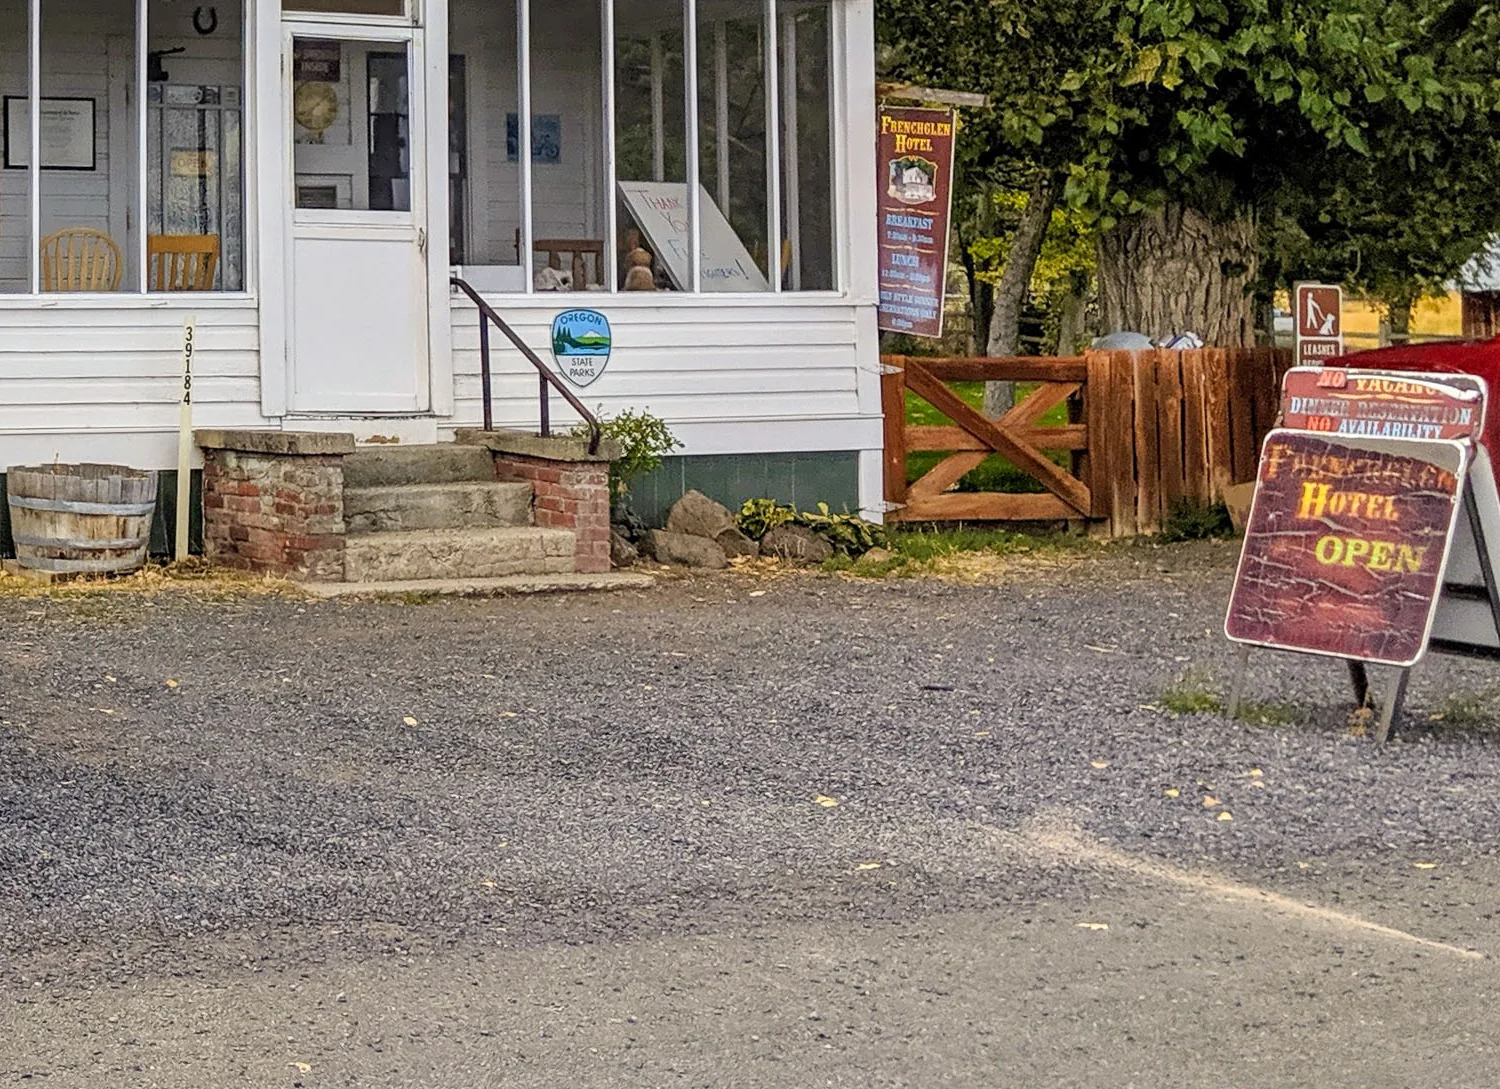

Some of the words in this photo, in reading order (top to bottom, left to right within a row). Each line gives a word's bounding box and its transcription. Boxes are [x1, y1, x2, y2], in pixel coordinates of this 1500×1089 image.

[881, 115, 951, 137] FRENCHGLEN
[895, 134, 933, 153] HOTEL
[560, 312, 603, 326] OREGON
[1303, 343, 1336, 356] LEASHES
[183, 326, 193, 405] 39184
[571, 358, 593, 367] STATE
[569, 368, 595, 377] PARKS
[1316, 370, 1346, 388] NO
[1307, 415, 1332, 431] NO
[1338, 418, 1443, 440] AVAILABILITY
[1295, 481, 1400, 521] HOTEL
[1315, 534, 1429, 573] OPEN
